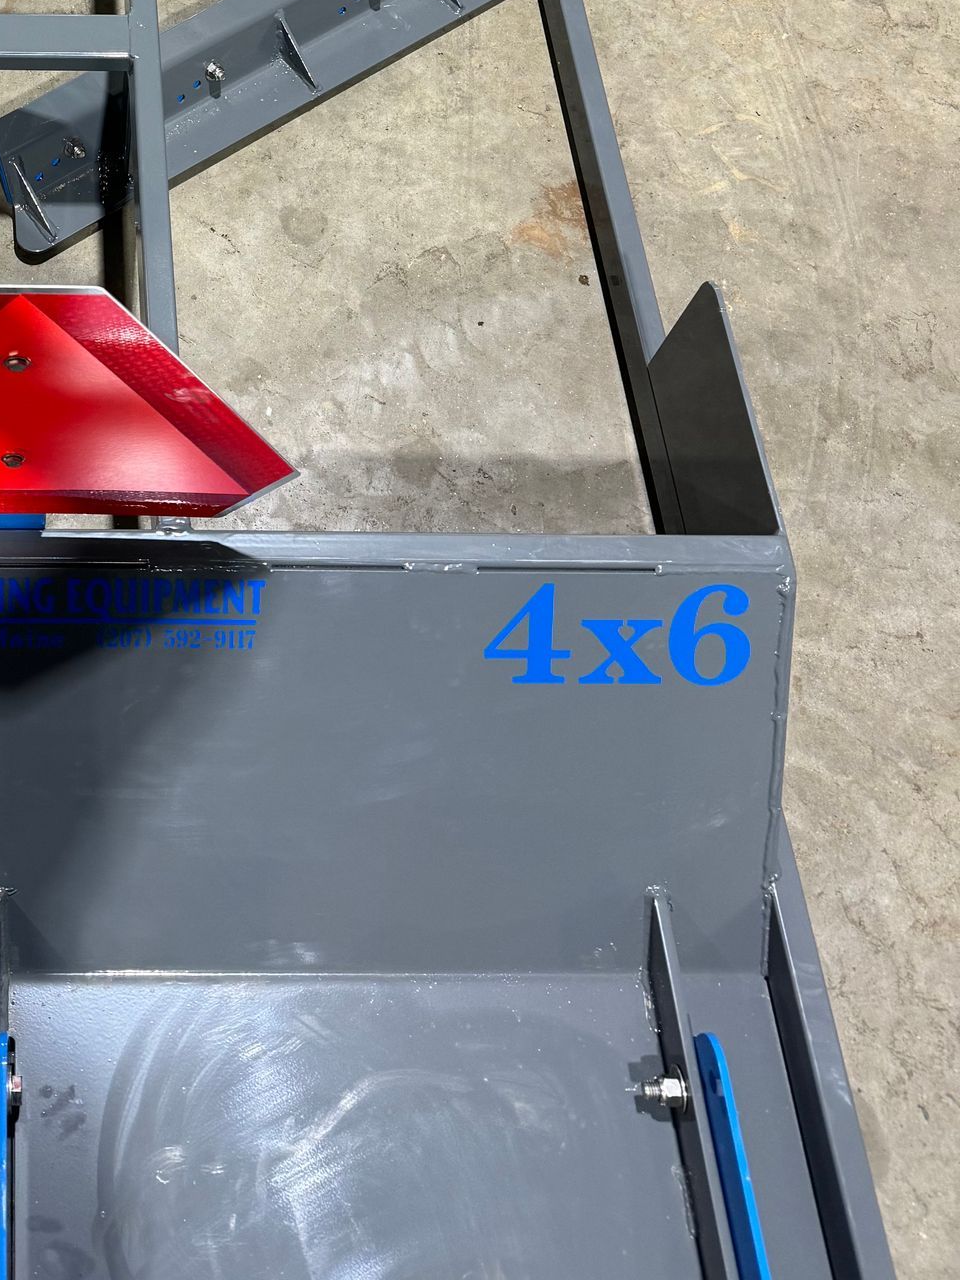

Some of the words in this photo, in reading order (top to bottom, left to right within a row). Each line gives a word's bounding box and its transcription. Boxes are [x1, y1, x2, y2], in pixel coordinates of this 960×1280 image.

[68, 579, 267, 616] EQUIPMENT
[96, 628, 152, 650] (207)
[163, 630, 257, 651] 592-9117
[483, 583, 751, 686] 4x6
